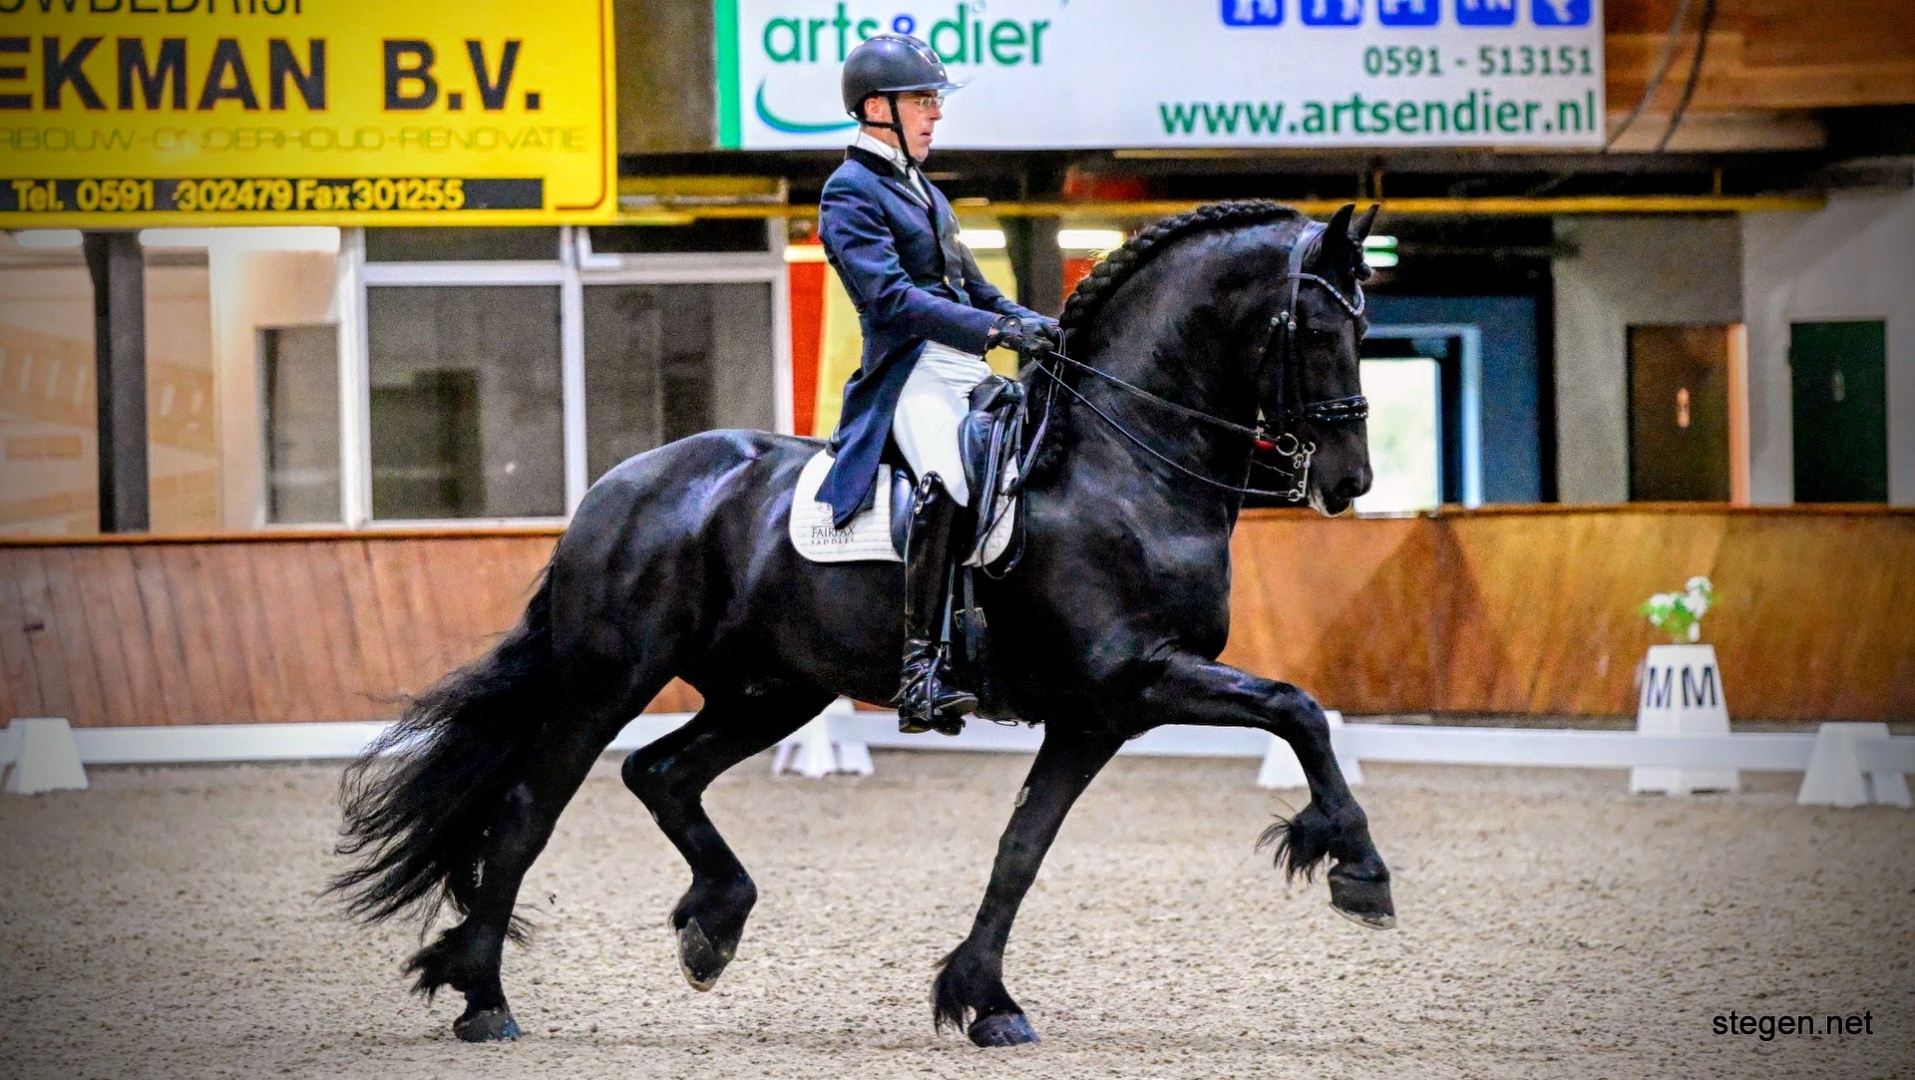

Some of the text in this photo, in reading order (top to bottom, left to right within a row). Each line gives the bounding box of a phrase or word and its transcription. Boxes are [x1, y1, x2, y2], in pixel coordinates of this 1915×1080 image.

[0, 37, 541, 110] EKMAN B.V.
[1364, 46, 1443, 75] 0591
[1479, 45, 1594, 75] 513151
[1160, 91, 1595, 134] www.artsendier.nl
[13, 181, 63, 210] Tel.
[77, 180, 153, 210] 0591
[173, 179, 293, 210] 302479
[1681, 666, 1717, 707] M
